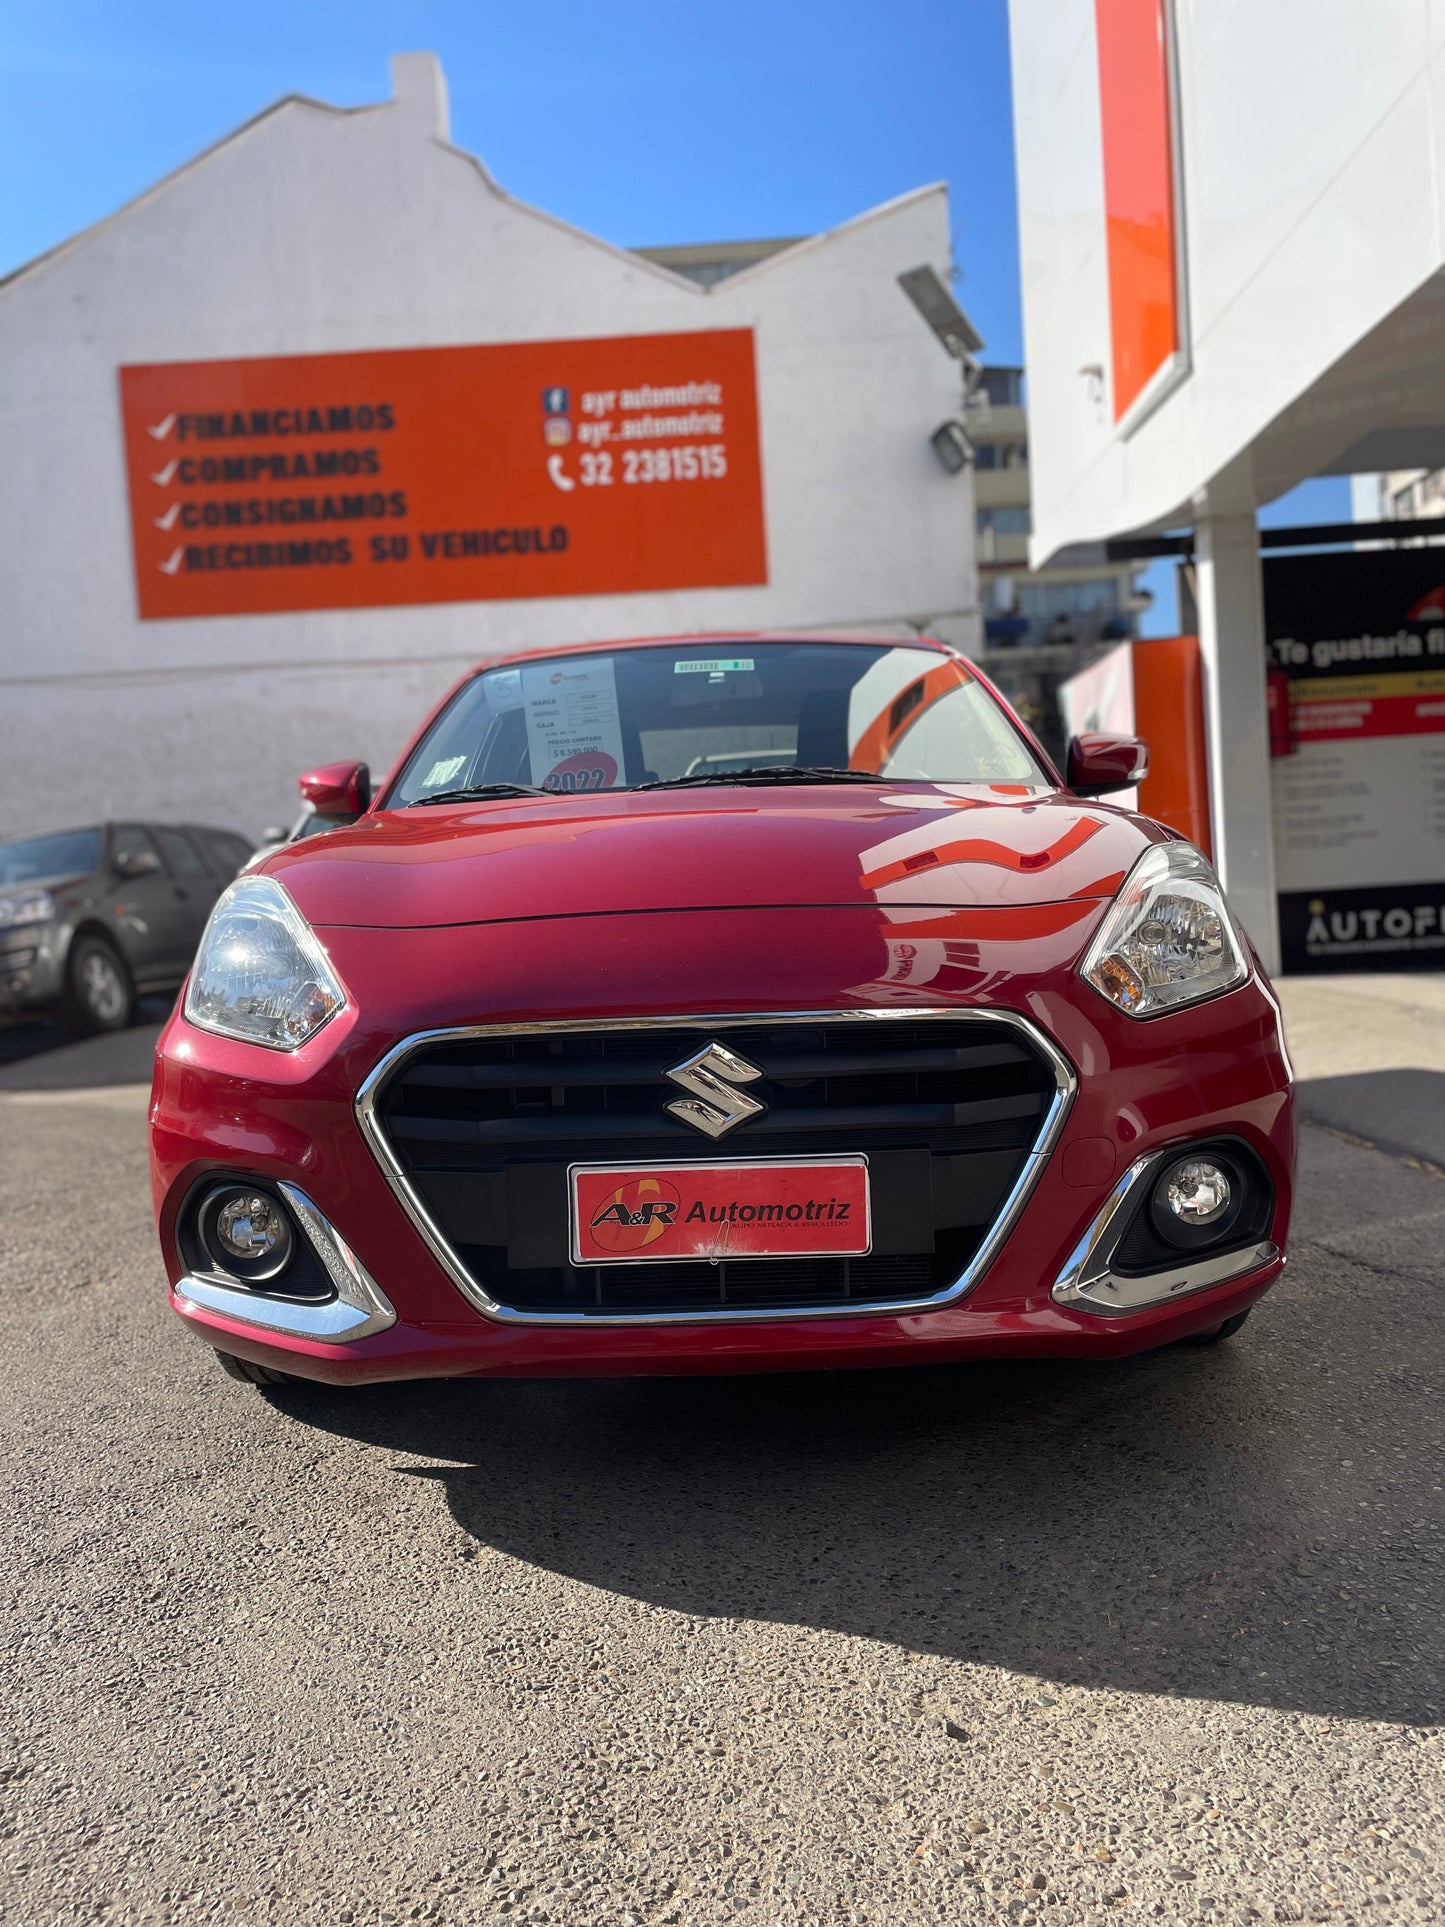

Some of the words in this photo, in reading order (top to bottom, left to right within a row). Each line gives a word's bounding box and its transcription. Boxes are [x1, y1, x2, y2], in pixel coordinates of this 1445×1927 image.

[581, 391, 615, 417] ayr
[620, 382, 722, 409] automotriz
[177, 403, 395, 441] FINANCIAMOS
[178, 448, 381, 483] COMPRAMOS
[580, 452, 613, 485] 32
[622, 445, 727, 484] 2381515
[180, 491, 408, 528] CONSIGNAMOS
[185, 537, 353, 571] RECIBIMOS
[371, 533, 409, 562] SU
[420, 526, 569, 559] VEHICULO
[1312, 629, 1423, 668] gustaría
[553, 749, 559, 758] $
[590, 1202, 676, 1227] A&R
[685, 1198, 851, 1223] Automotriz
